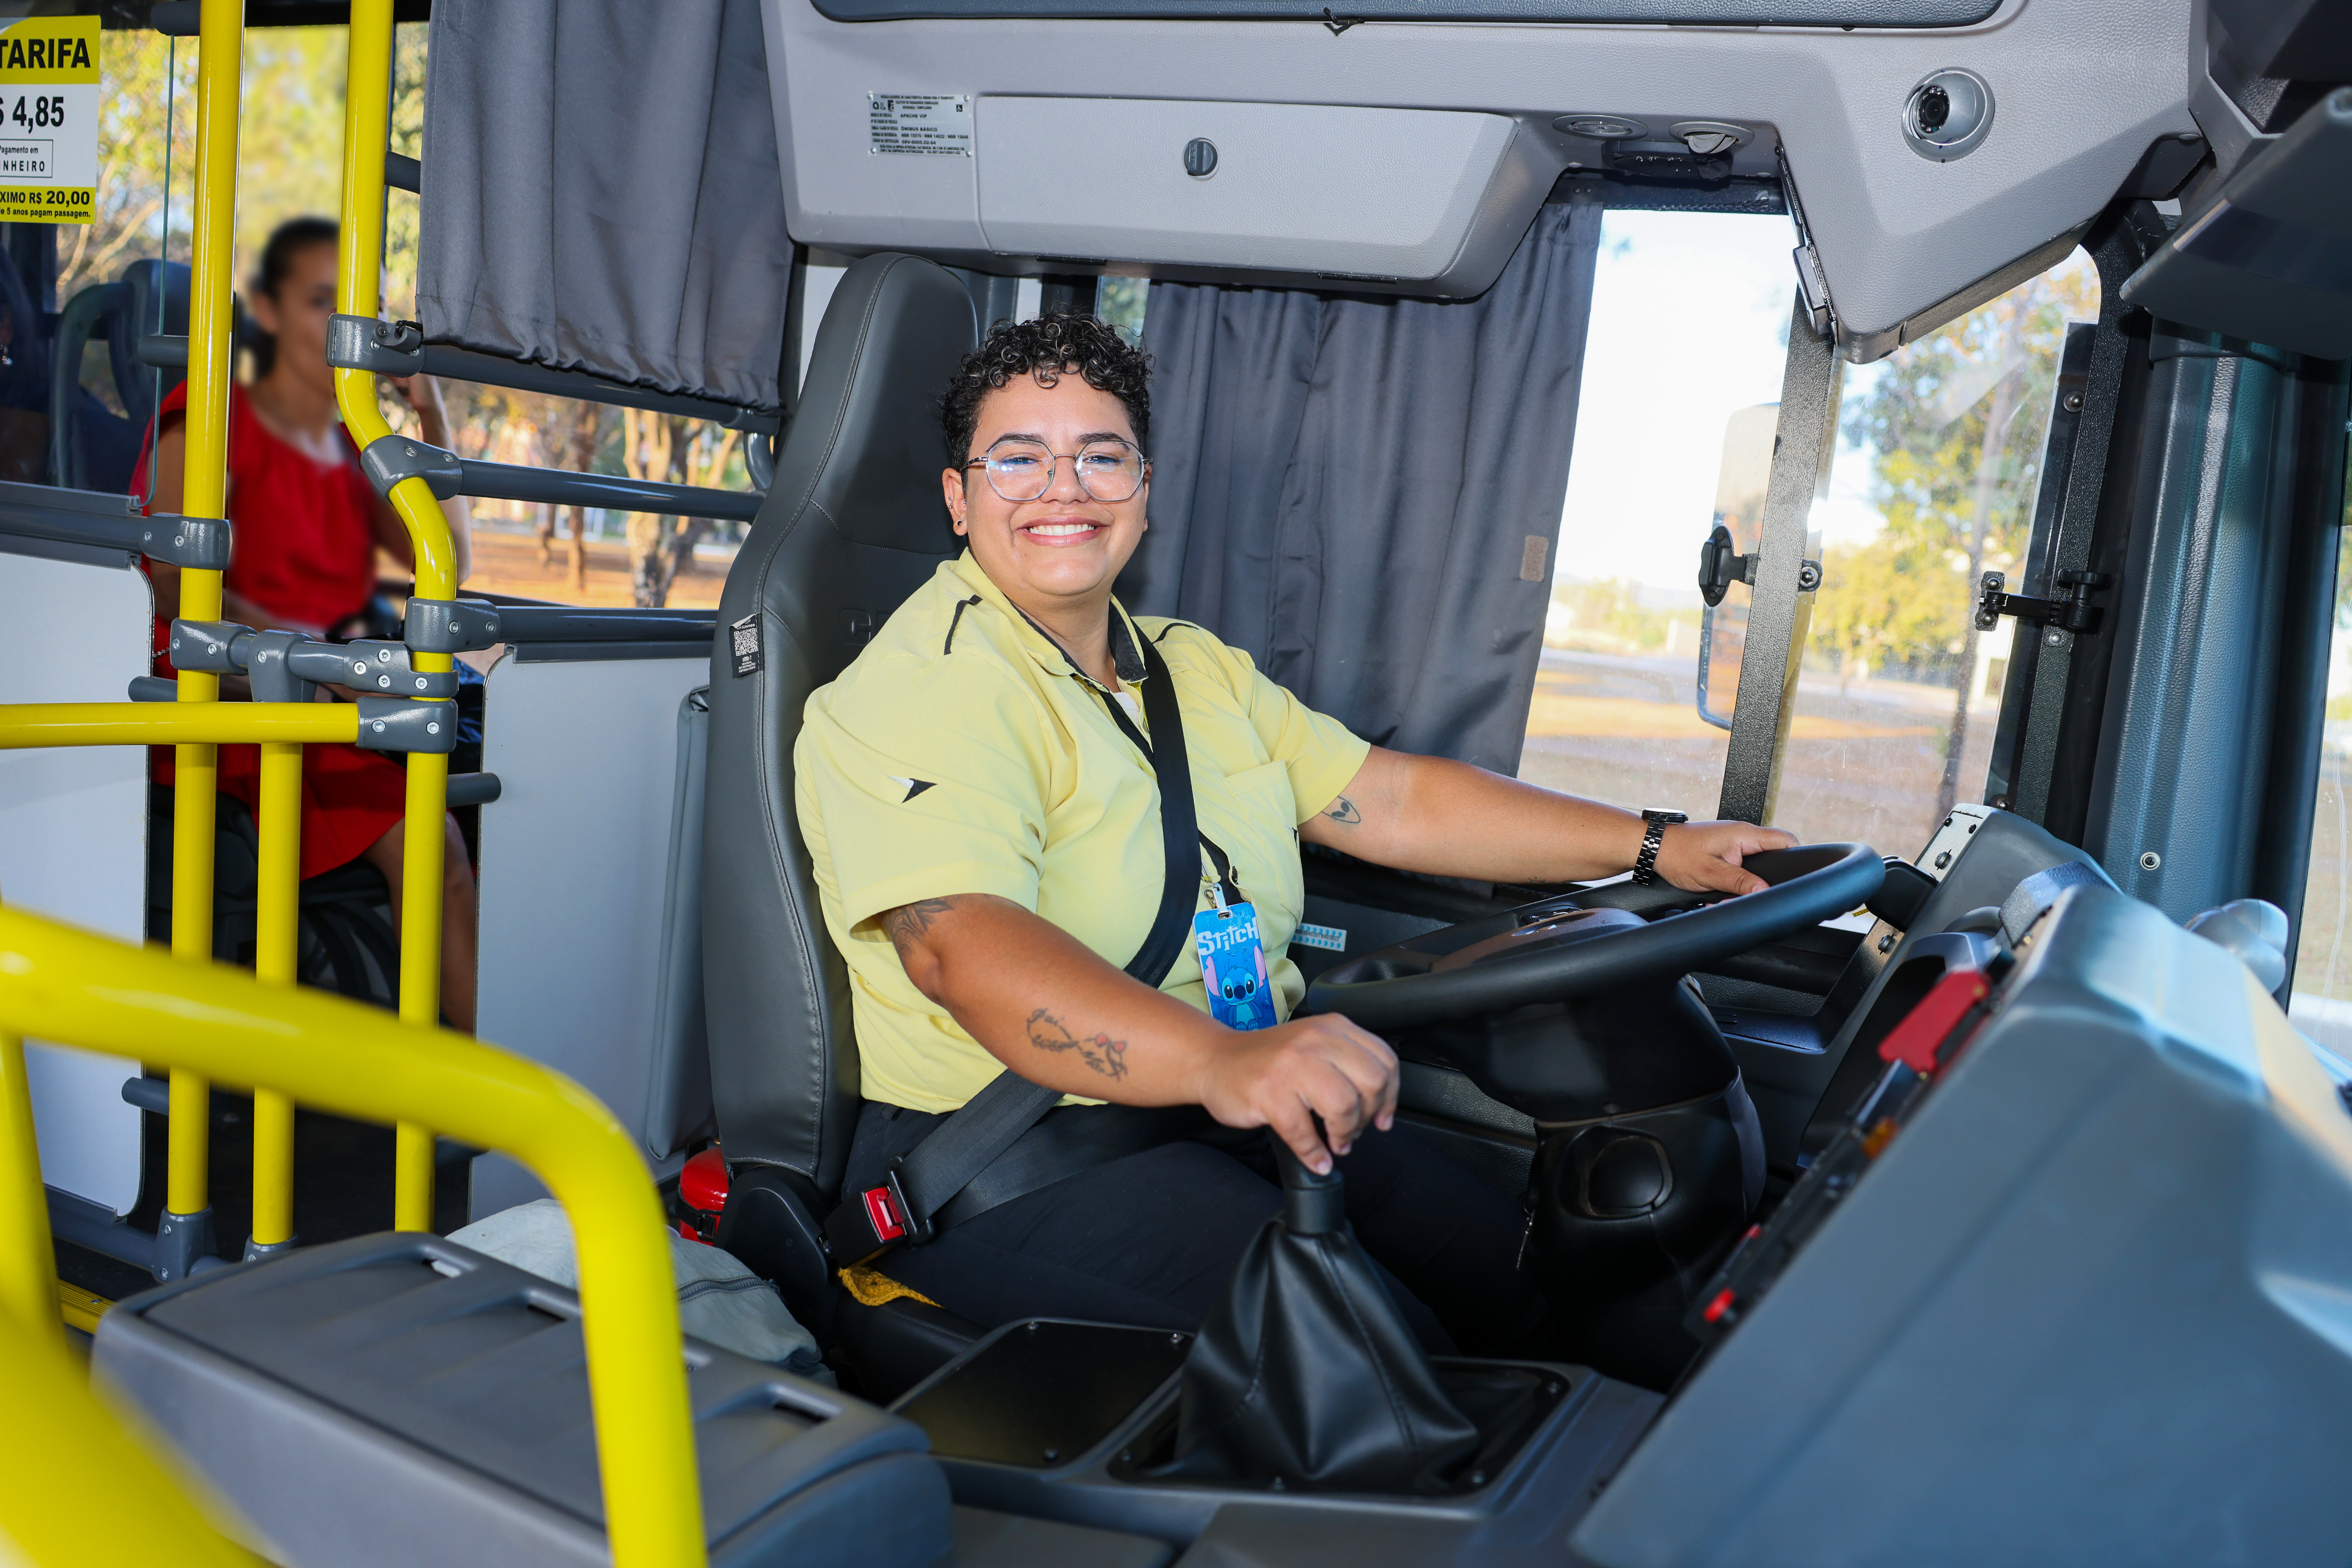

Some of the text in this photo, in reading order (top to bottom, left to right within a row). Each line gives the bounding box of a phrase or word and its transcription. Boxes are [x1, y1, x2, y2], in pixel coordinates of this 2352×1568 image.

[13, 96, 64, 134] 4,85
[0, 145, 28, 155] agamento
[0, 160, 45, 172] NHEIRO
[29, 192, 41, 204] R$
[46, 191, 90, 207] 20,00
[54, 210, 90, 219] passagem.
[1196, 917, 1259, 956] Stitch
